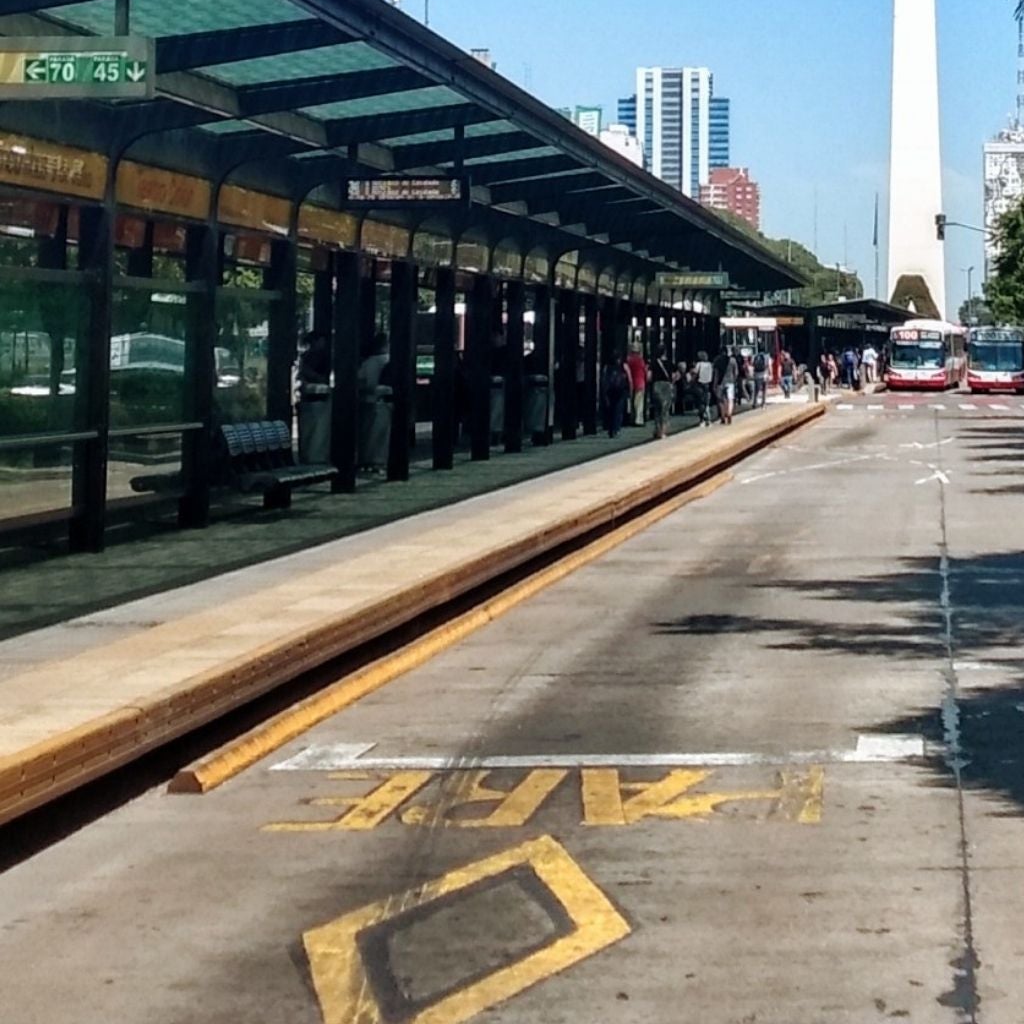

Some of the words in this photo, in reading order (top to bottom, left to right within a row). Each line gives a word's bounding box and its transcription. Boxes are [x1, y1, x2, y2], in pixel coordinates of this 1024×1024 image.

[49, 62, 75, 81] 70
[93, 62, 119, 81] 45
[898, 331, 918, 340] 100
[260, 765, 825, 832] PARE
